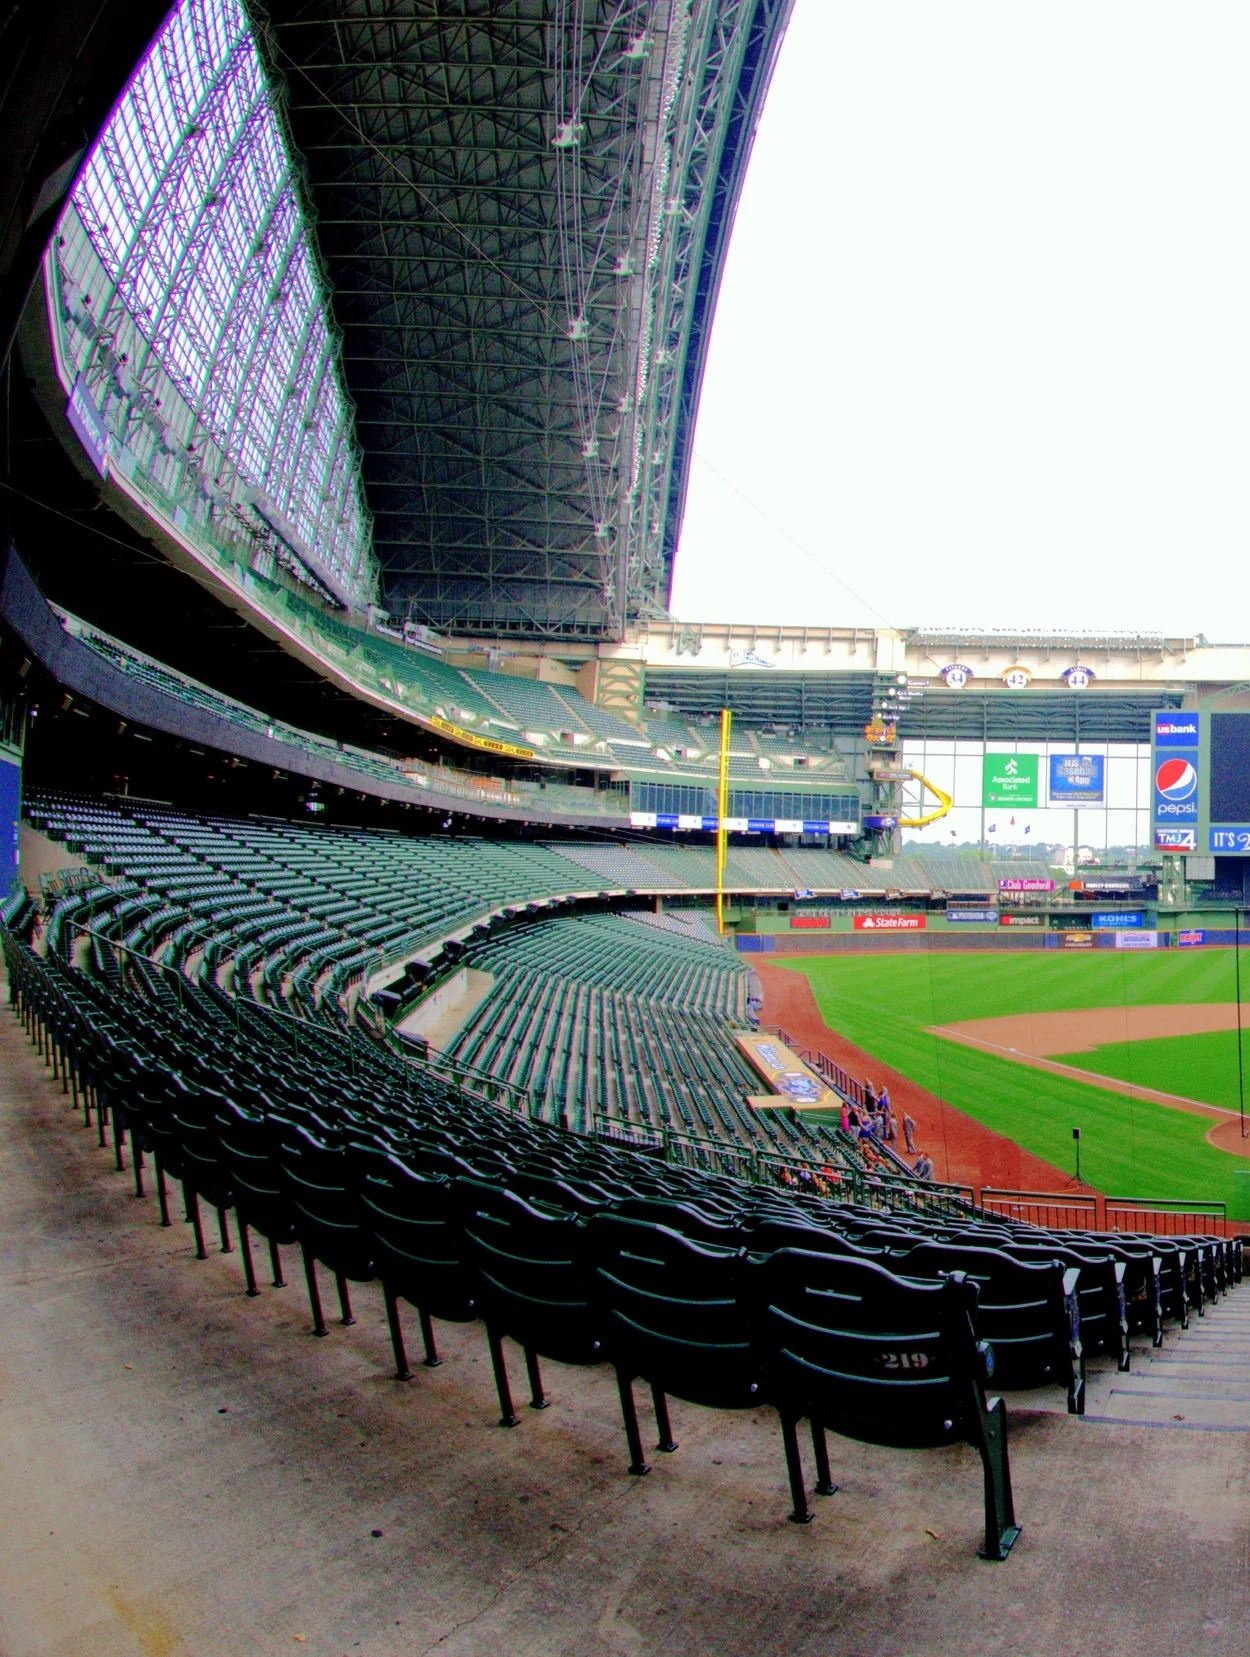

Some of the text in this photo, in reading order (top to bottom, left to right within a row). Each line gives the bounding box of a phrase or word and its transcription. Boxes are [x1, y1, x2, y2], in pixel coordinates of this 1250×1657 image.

[949, 673, 963, 684] 34
[1009, 674, 1024, 685] 42
[1071, 674, 1086, 685] 44
[1056, 766, 1098, 777] Baseball
[992, 776, 1031, 784] Associated
[1158, 802, 1195, 816] pepsi
[1213, 832, 1235, 848] IT'S
[1007, 880, 1051, 890] Club Goodwill
[1009, 915, 1040, 925] impact
[1179, 932, 1203, 944] meijer
[881, 1353, 930, 1369] 219
